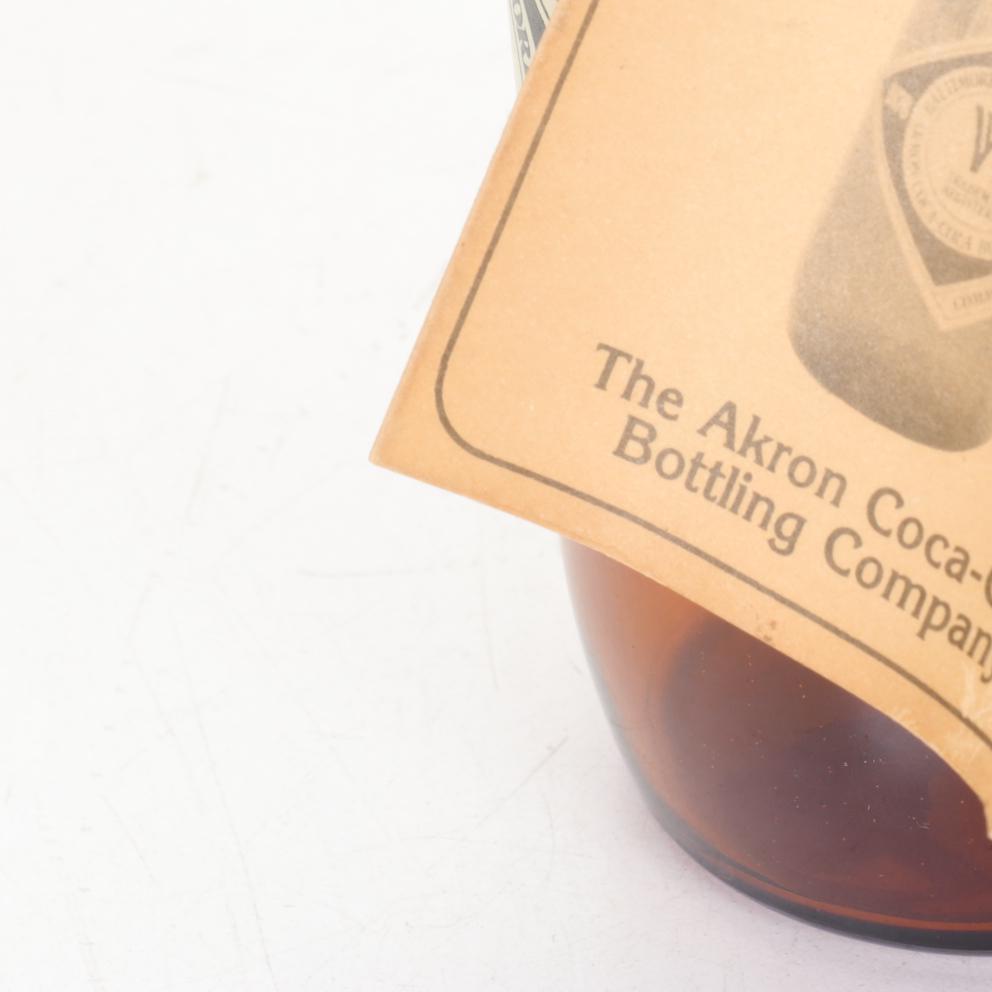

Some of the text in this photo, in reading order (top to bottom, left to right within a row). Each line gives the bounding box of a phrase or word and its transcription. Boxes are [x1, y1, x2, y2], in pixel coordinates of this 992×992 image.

[594, 343, 684, 421] The
[697, 401, 848, 508] Akron
[611, 414, 807, 557] Bottling
